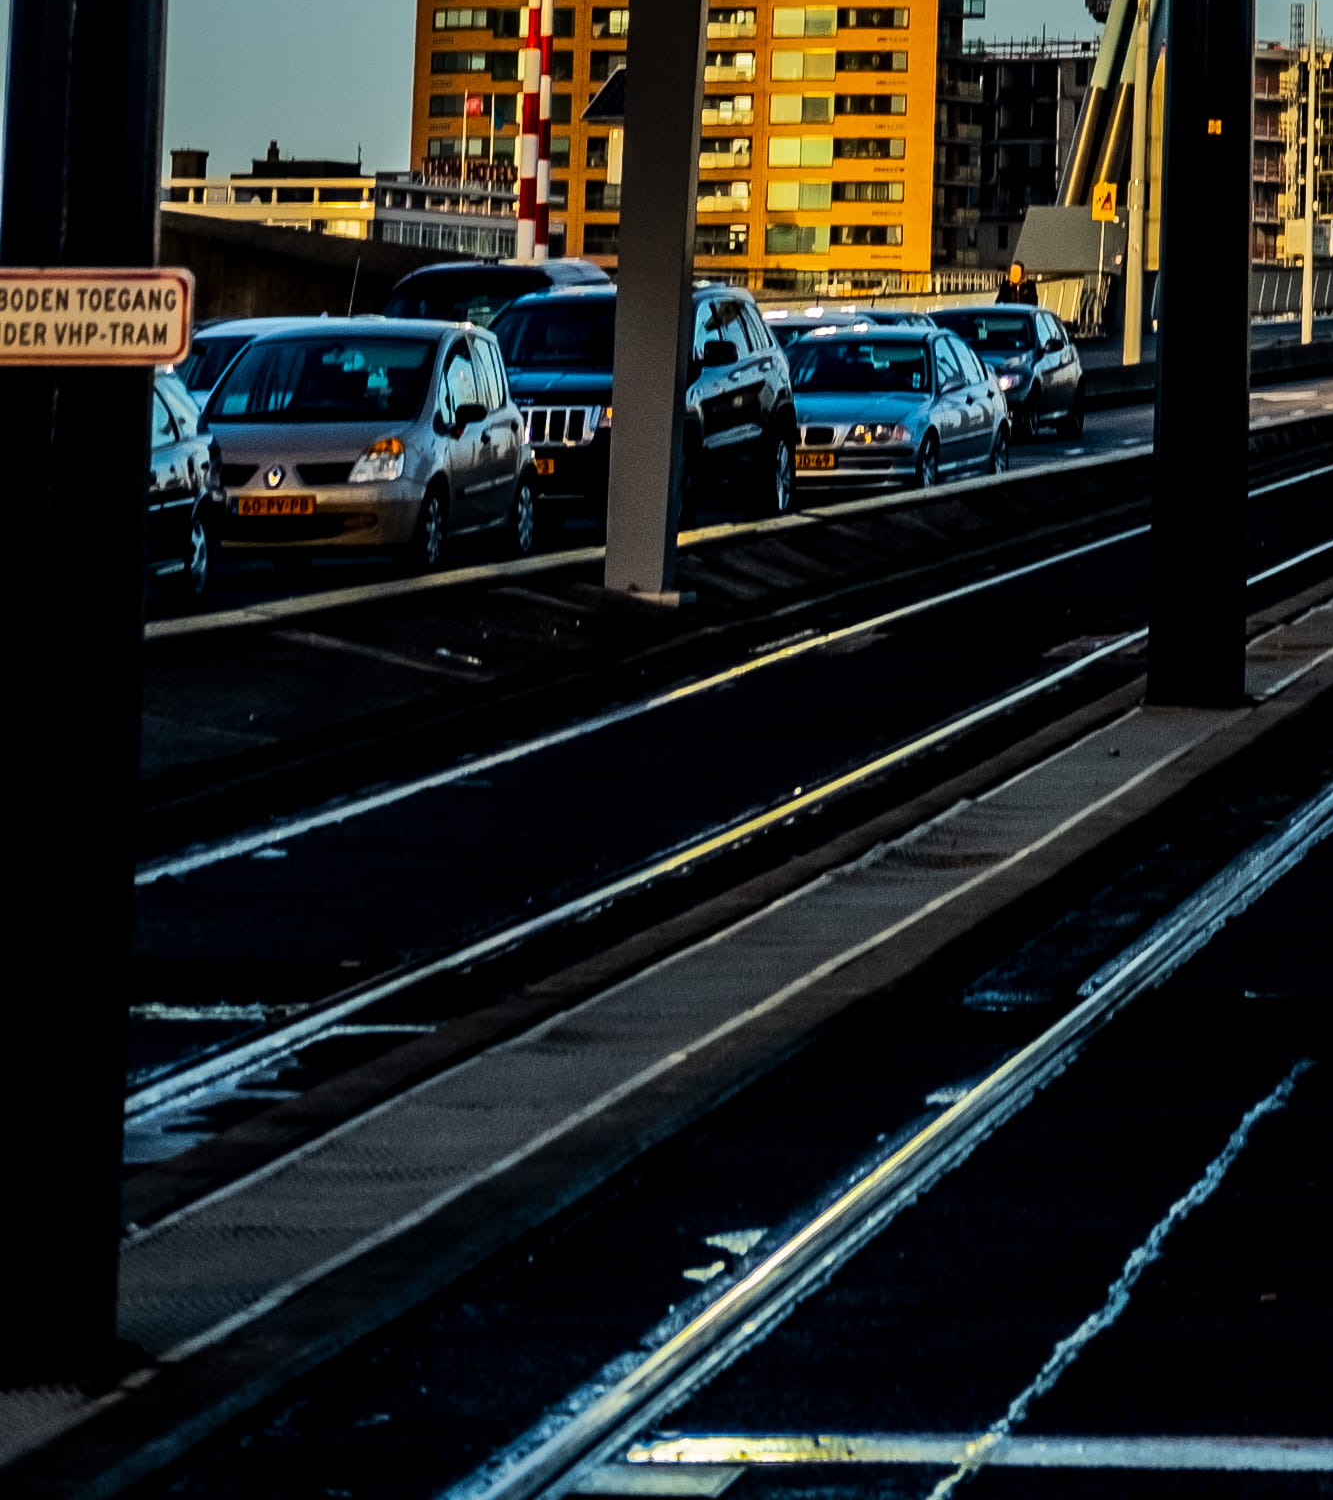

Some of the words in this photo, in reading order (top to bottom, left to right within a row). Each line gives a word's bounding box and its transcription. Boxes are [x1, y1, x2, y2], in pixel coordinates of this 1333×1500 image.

[76, 288, 178, 313] TOEGANG
[0, 322, 47, 346] DER
[54, 322, 169, 346] VHP-TRAM
